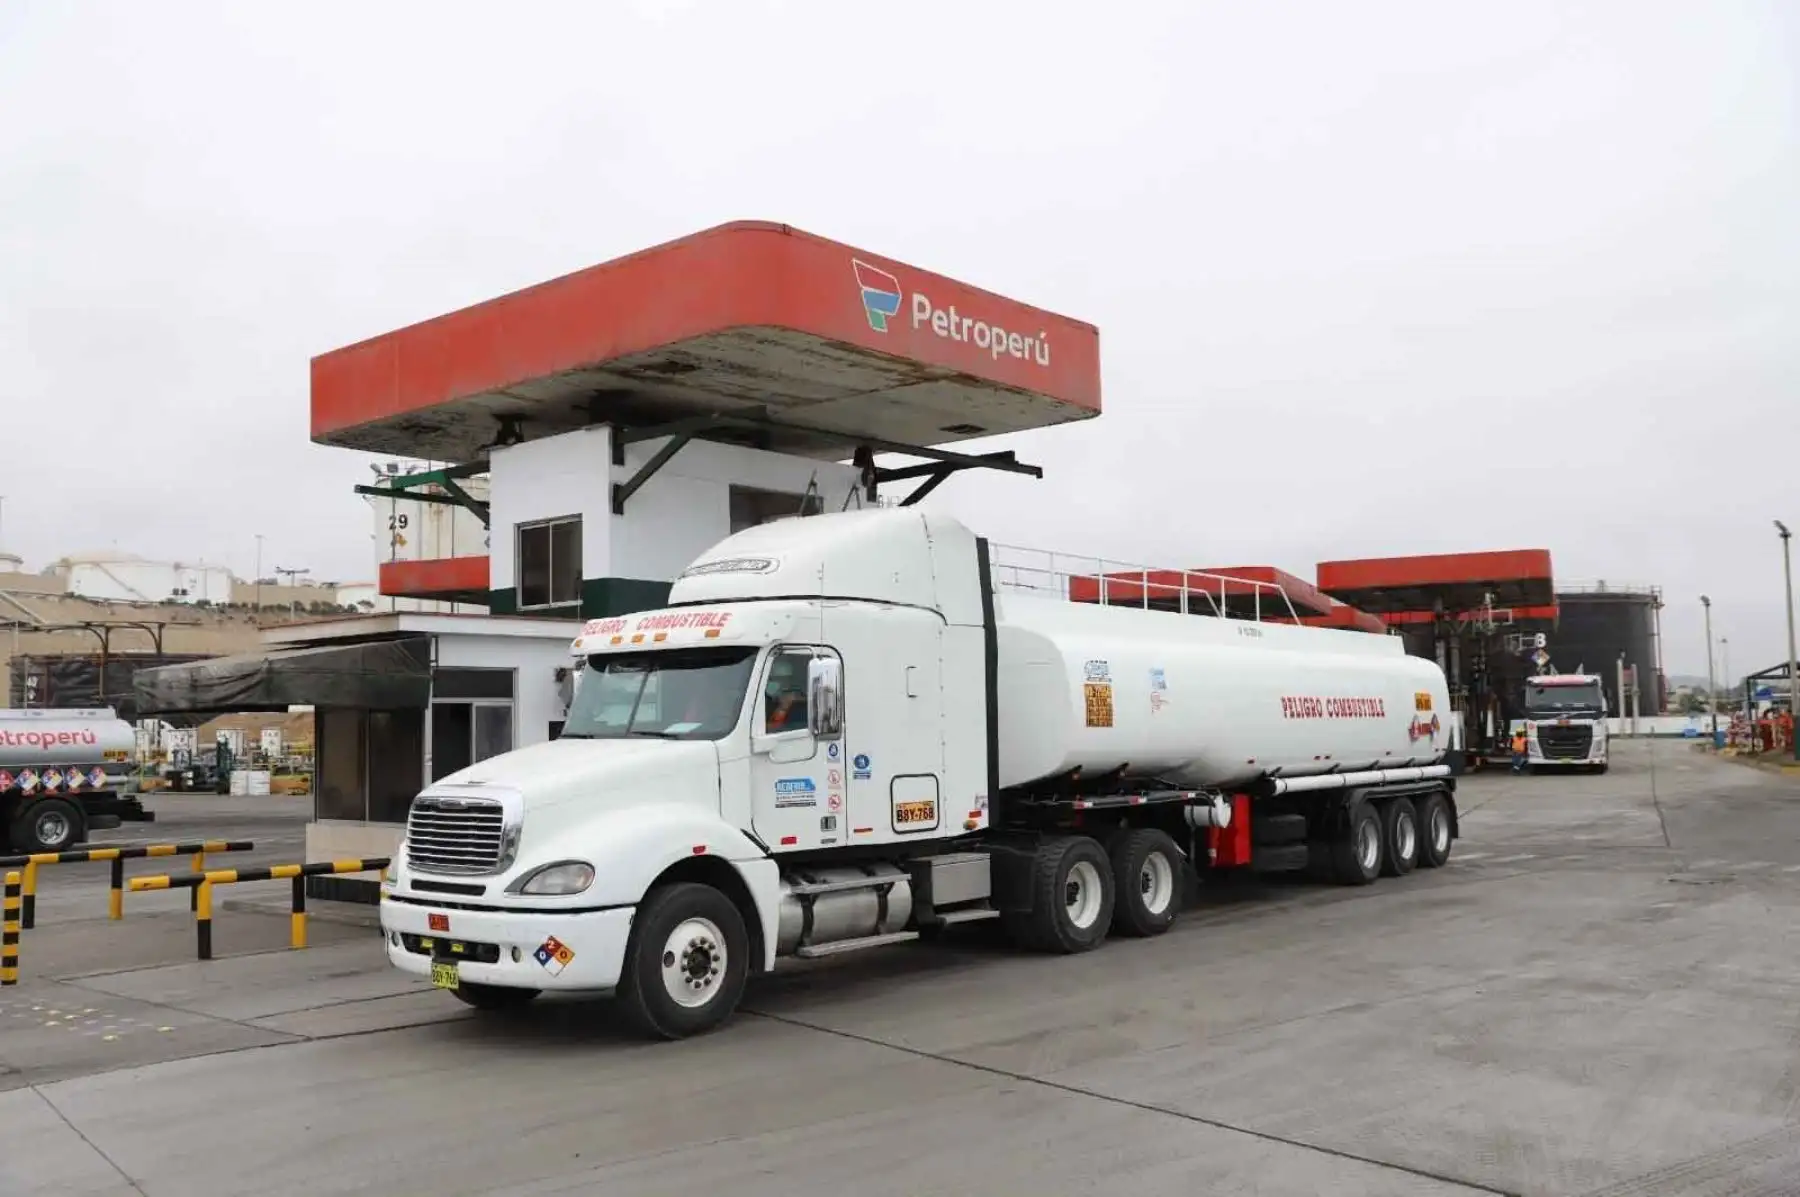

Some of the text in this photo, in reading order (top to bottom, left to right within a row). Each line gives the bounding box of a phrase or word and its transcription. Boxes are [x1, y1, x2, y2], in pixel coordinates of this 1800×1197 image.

[912, 292, 1050, 366] Petroperú
[389, 514, 408, 530] 29
[582, 613, 732, 636] PELIGRO COMBUSTIBLE
[1281, 697, 1385, 718] PELIGRO COMBUSTIBLE
[548, 939, 556, 949] 2
